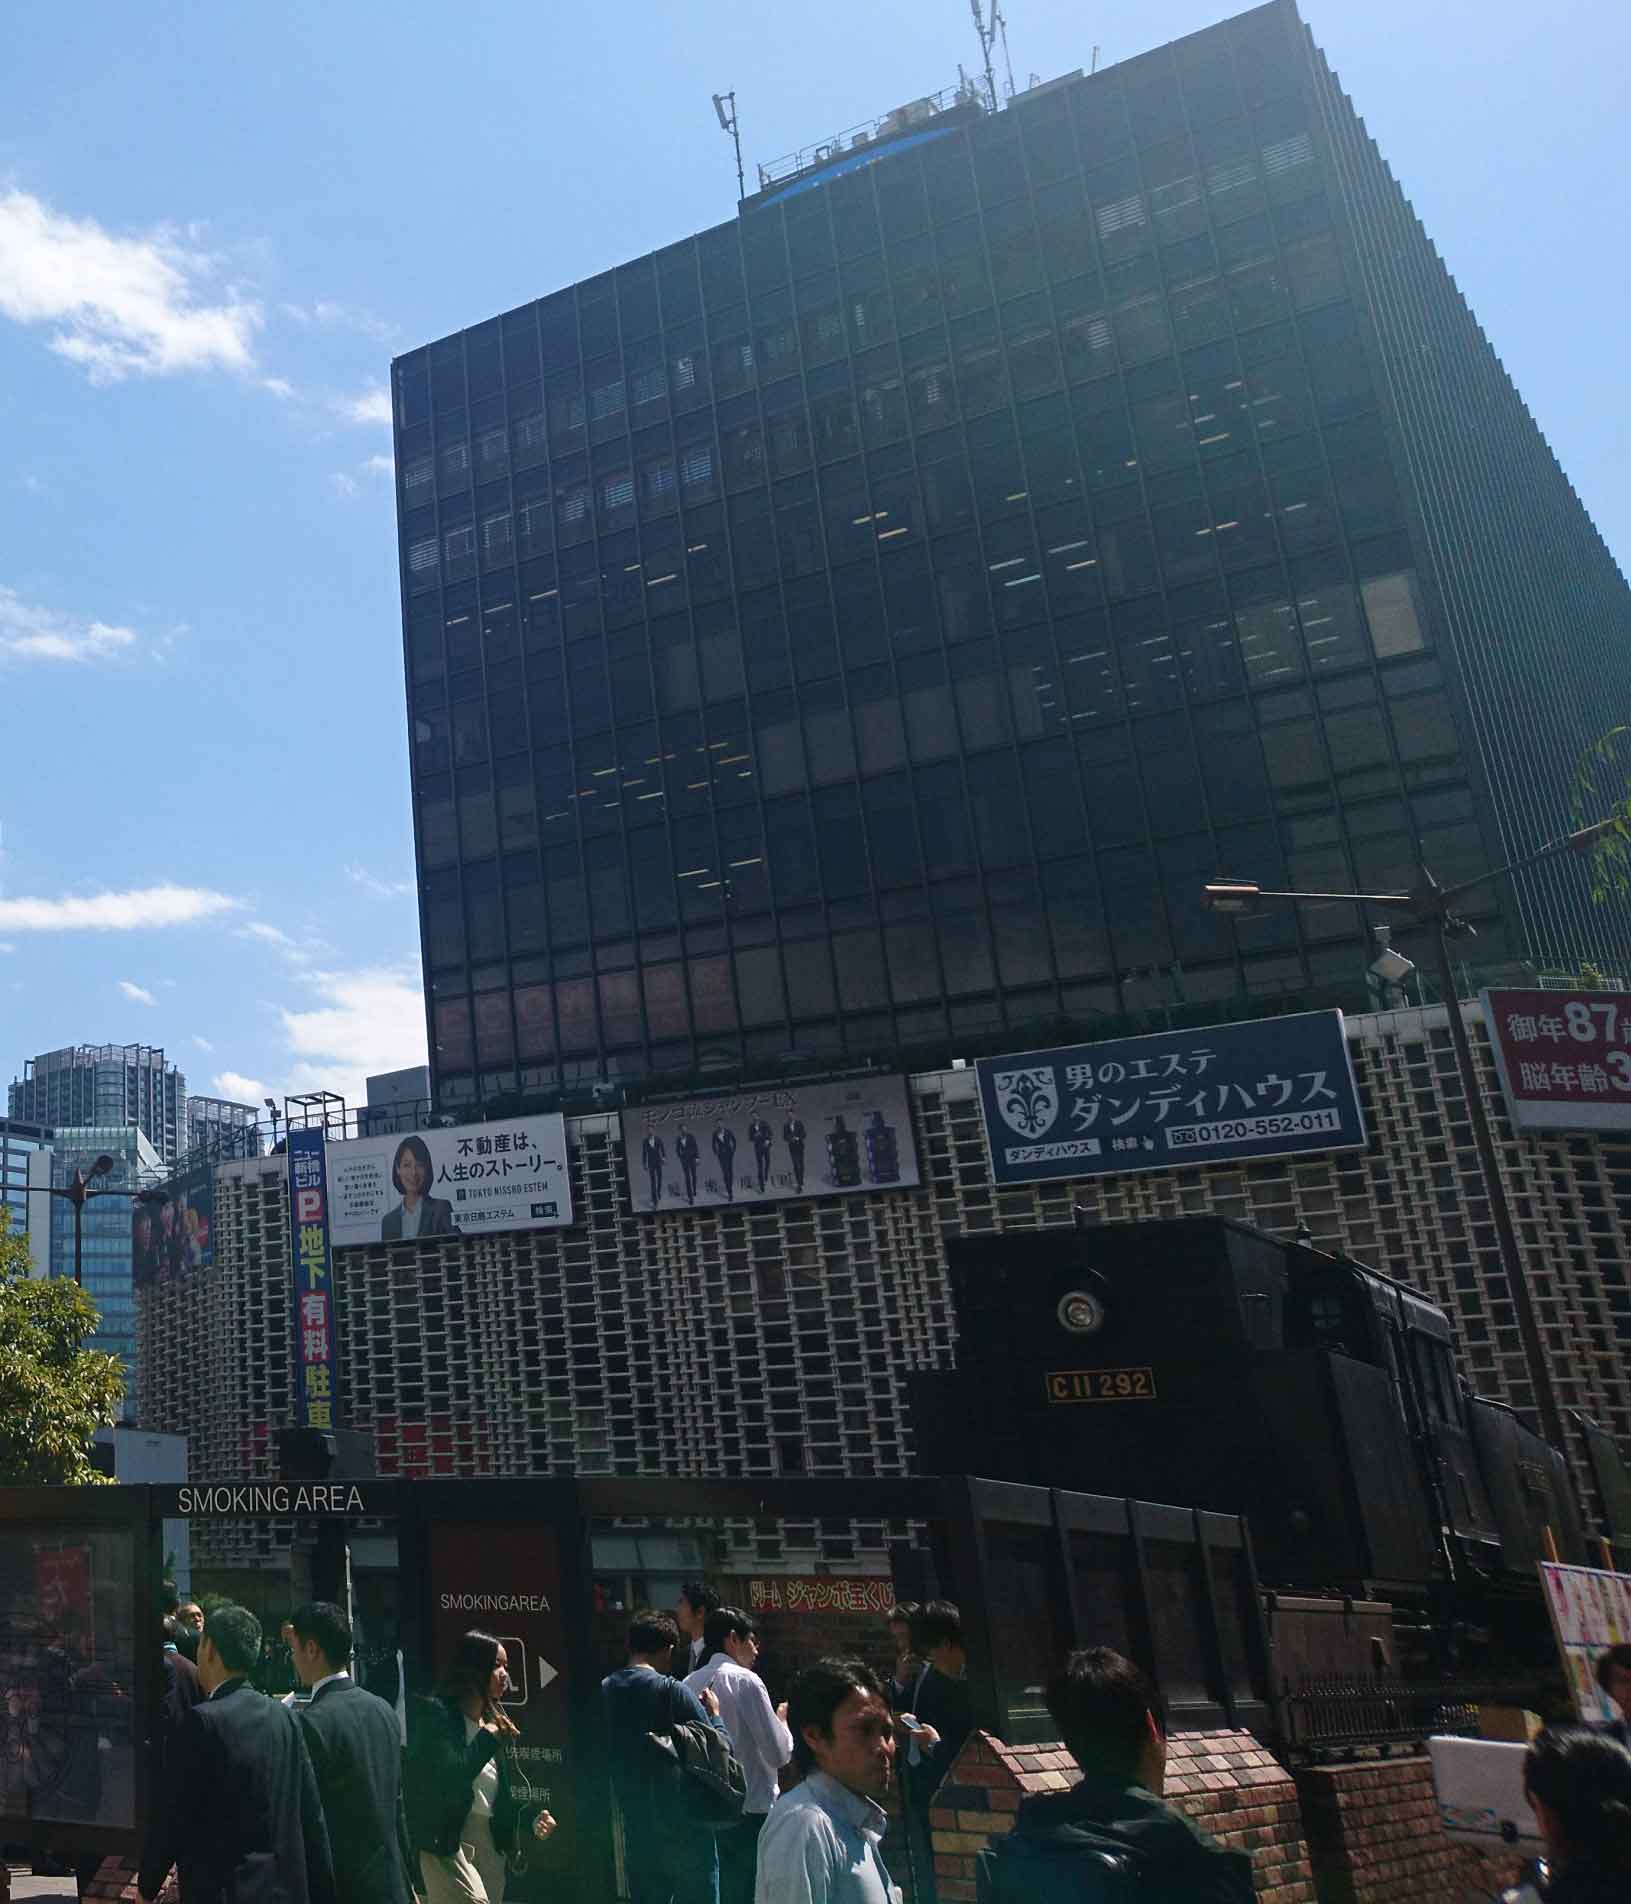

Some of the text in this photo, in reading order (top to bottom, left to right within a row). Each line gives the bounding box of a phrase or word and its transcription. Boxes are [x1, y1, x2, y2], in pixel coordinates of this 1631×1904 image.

[1064, 1049, 1217, 1092] 男のエステ
[1069, 1070, 1337, 1133] ダンディハウス
[1198, 1112, 1335, 1143] 0120-552-011
[457, 1132, 538, 1157] 不動産は、
[295, 1175, 321, 1188] ビル
[437, 1155, 564, 1184] 人生のストーリー。
[1099, 1373, 1150, 1395] 292
[178, 1486, 365, 1513] SMOKING AREA
